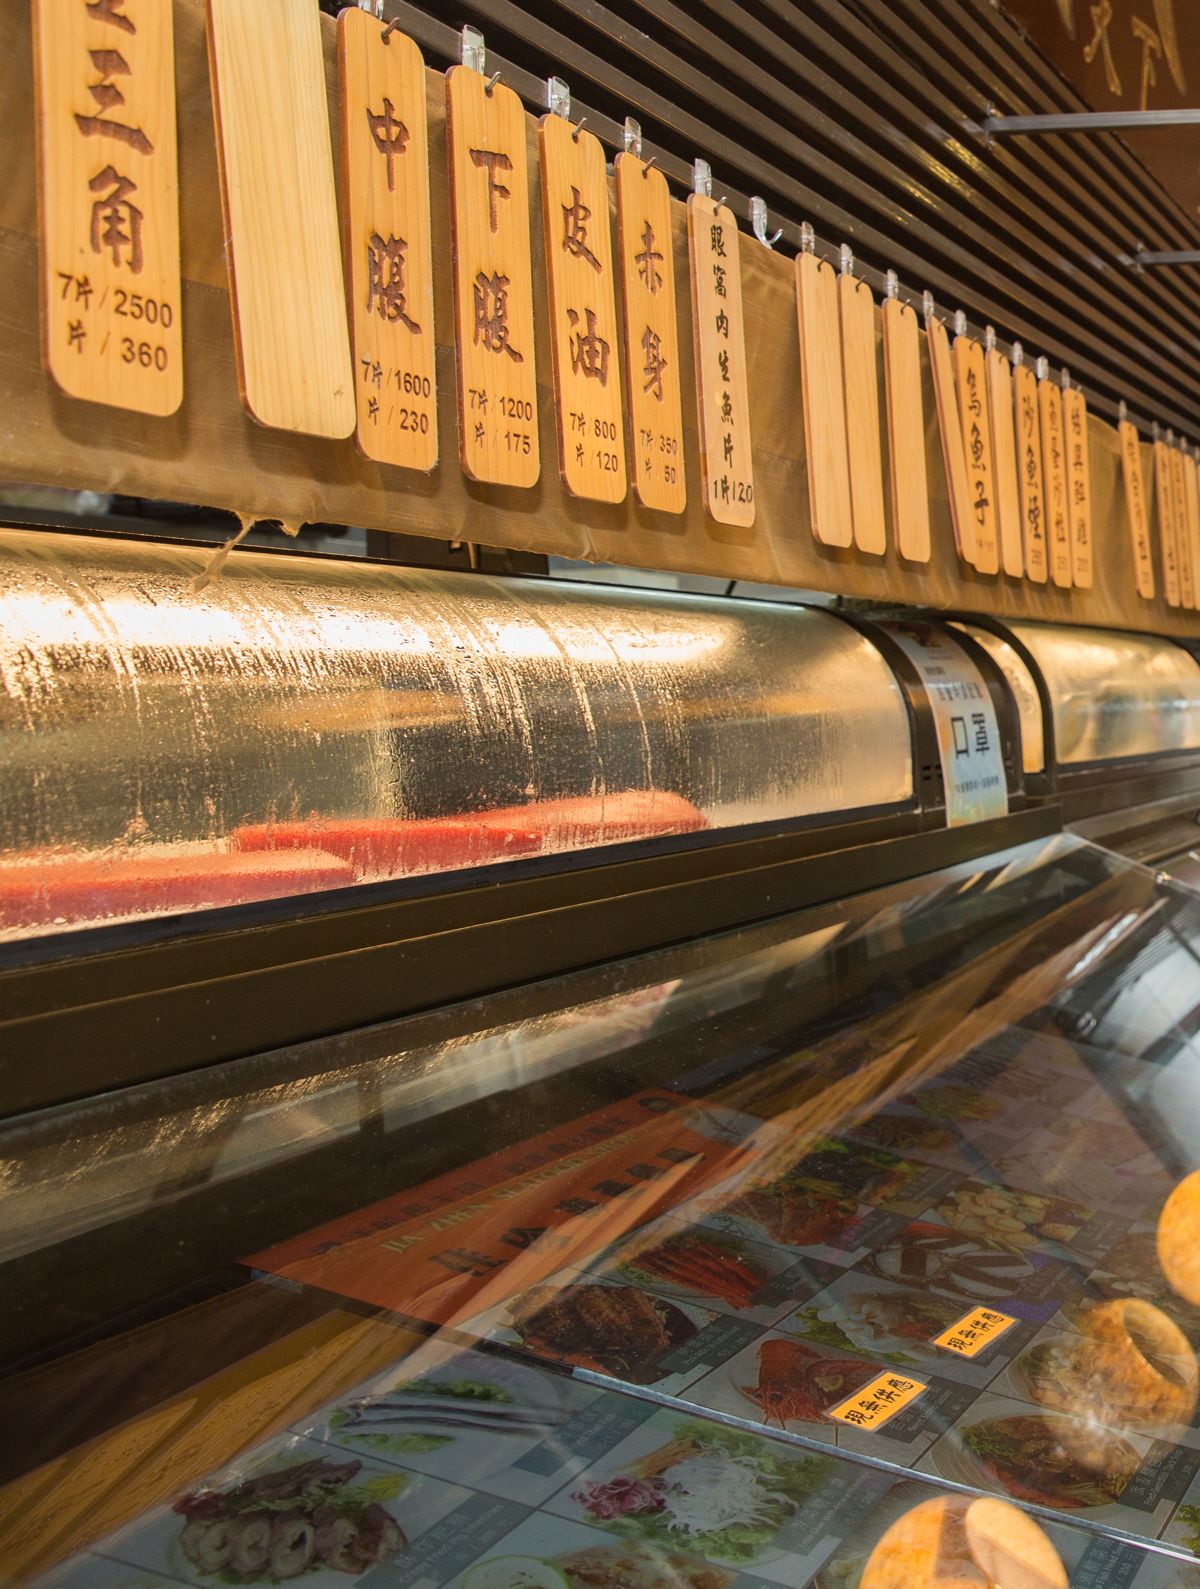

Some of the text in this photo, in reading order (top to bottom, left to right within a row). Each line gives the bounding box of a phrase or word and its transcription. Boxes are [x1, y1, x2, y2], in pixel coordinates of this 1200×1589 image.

[365, 97, 421, 335] 中腹
[469, 148, 524, 363] 下腹
[561, 185, 610, 388] 皮油
[634, 220, 667, 404] 赤身
[710, 224, 735, 468] 眼窩肉生魚片
[844, 1378, 914, 1425] 現無供應
